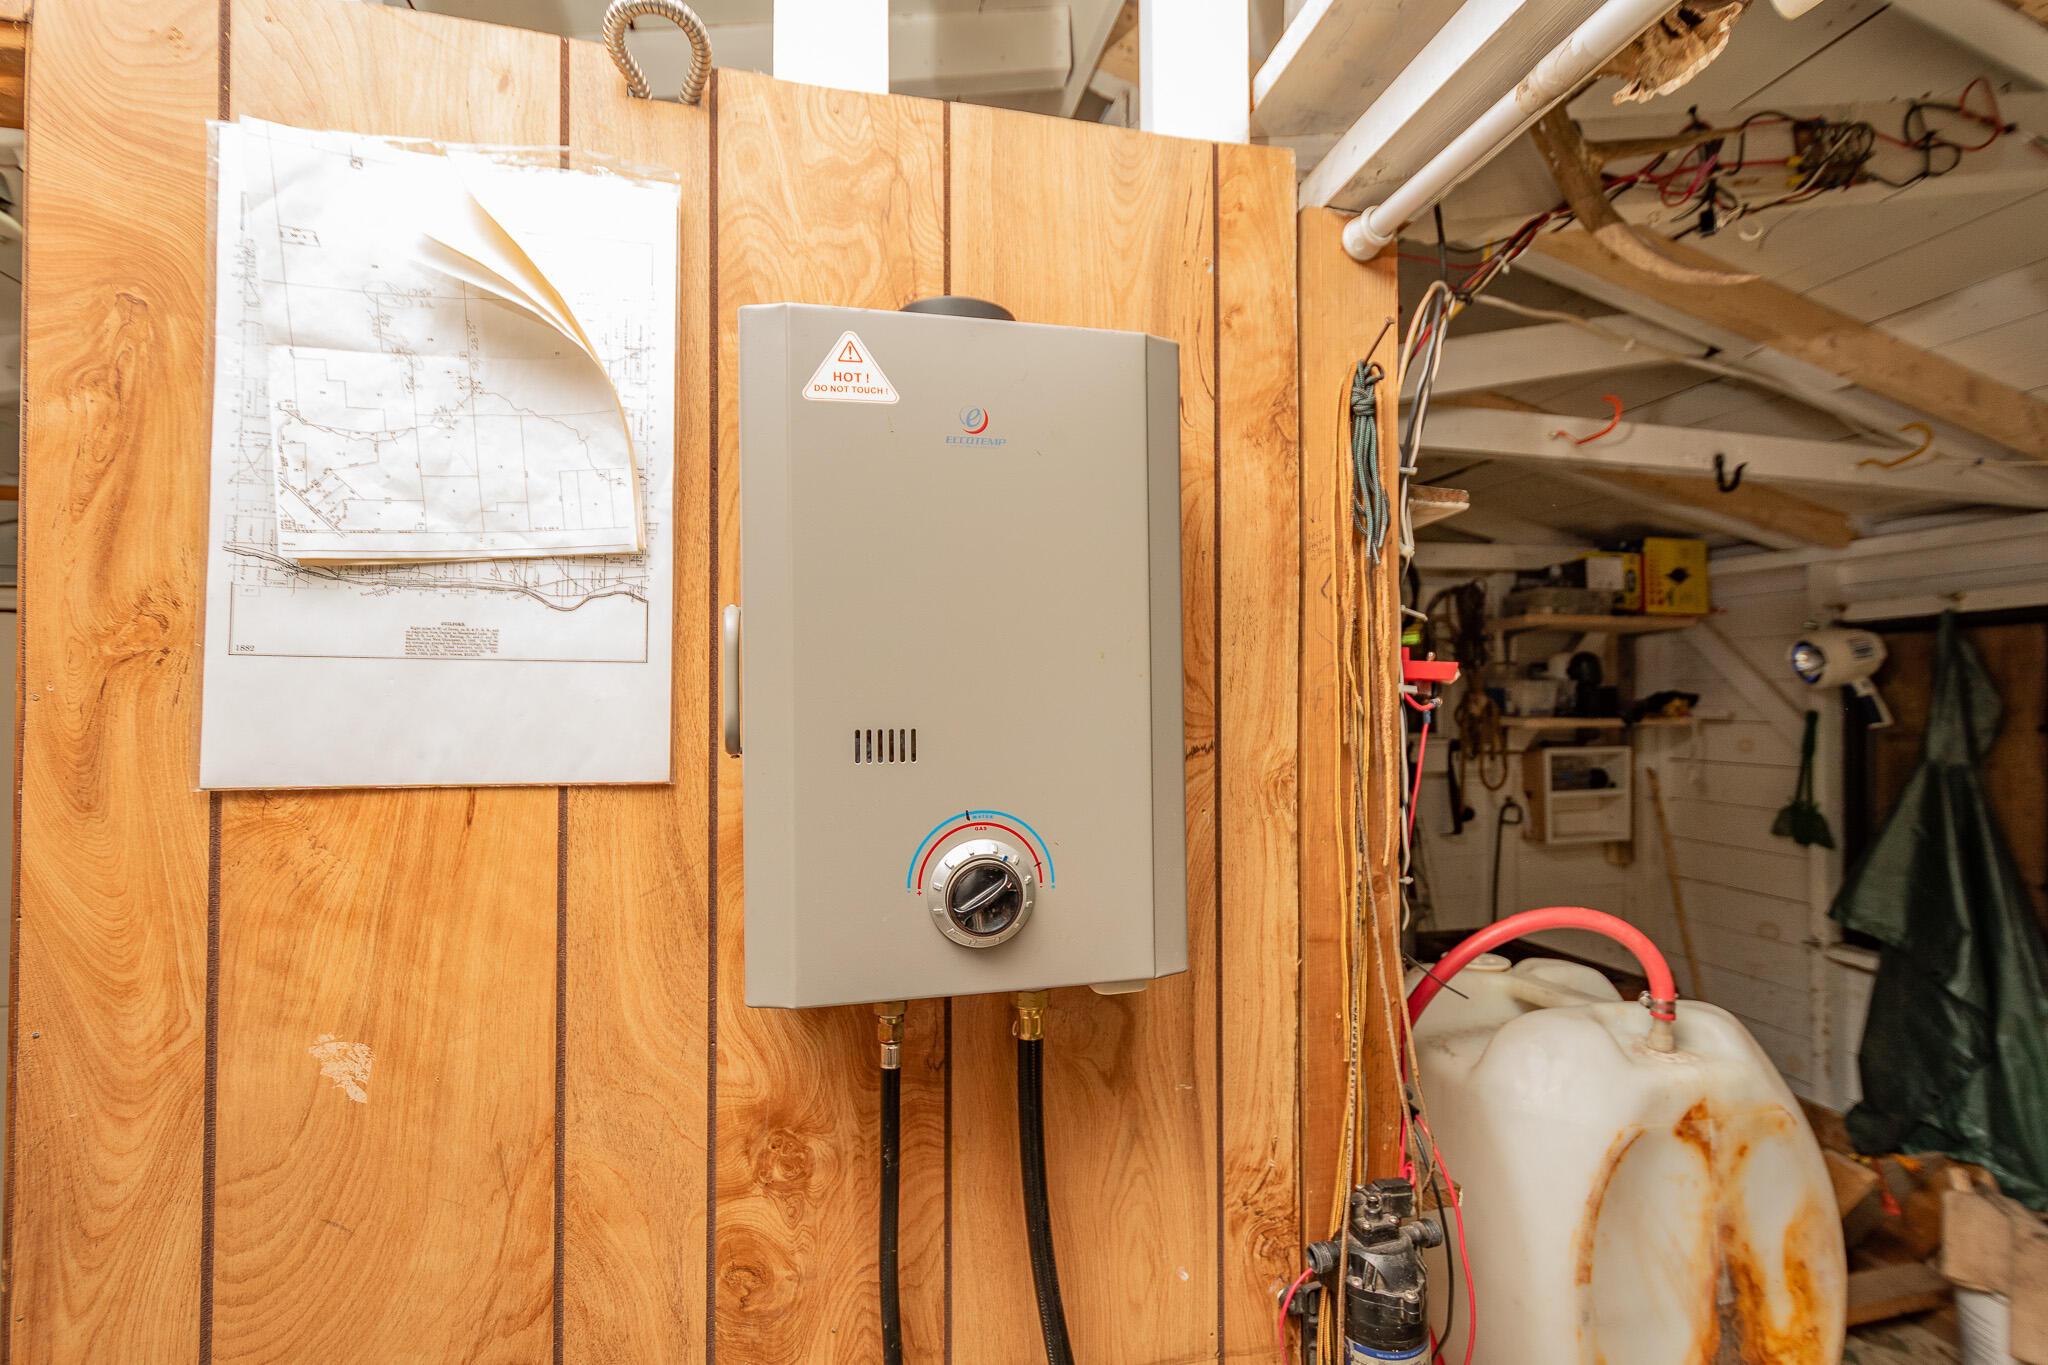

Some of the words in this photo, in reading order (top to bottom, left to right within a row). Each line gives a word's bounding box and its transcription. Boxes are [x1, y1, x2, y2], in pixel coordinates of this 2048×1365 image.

[833, 372, 862, 383] HOT
[830, 385, 849, 393] NOT
[852, 386, 883, 394] TOUCH
[945, 435, 1007, 446] ECCOTEMP
[235, 644, 255, 652] 1882
